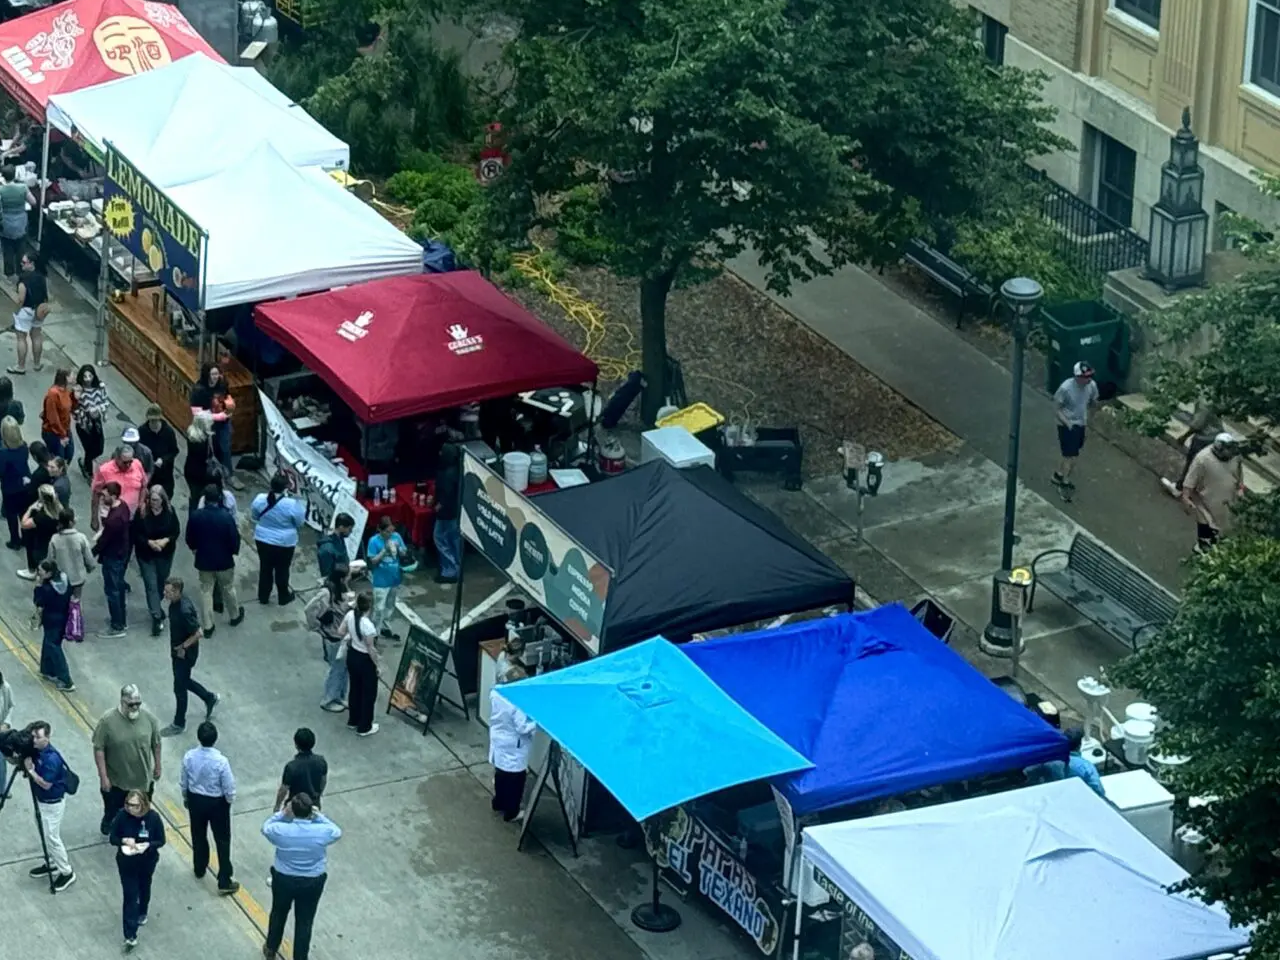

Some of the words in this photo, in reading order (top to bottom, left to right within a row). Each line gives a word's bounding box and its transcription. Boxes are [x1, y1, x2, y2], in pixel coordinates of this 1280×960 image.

[107, 148, 198, 258] LEMONADE
[111, 201, 126, 212] Free
[668, 840, 692, 885] EL
[699, 863, 767, 941] TEXANO
